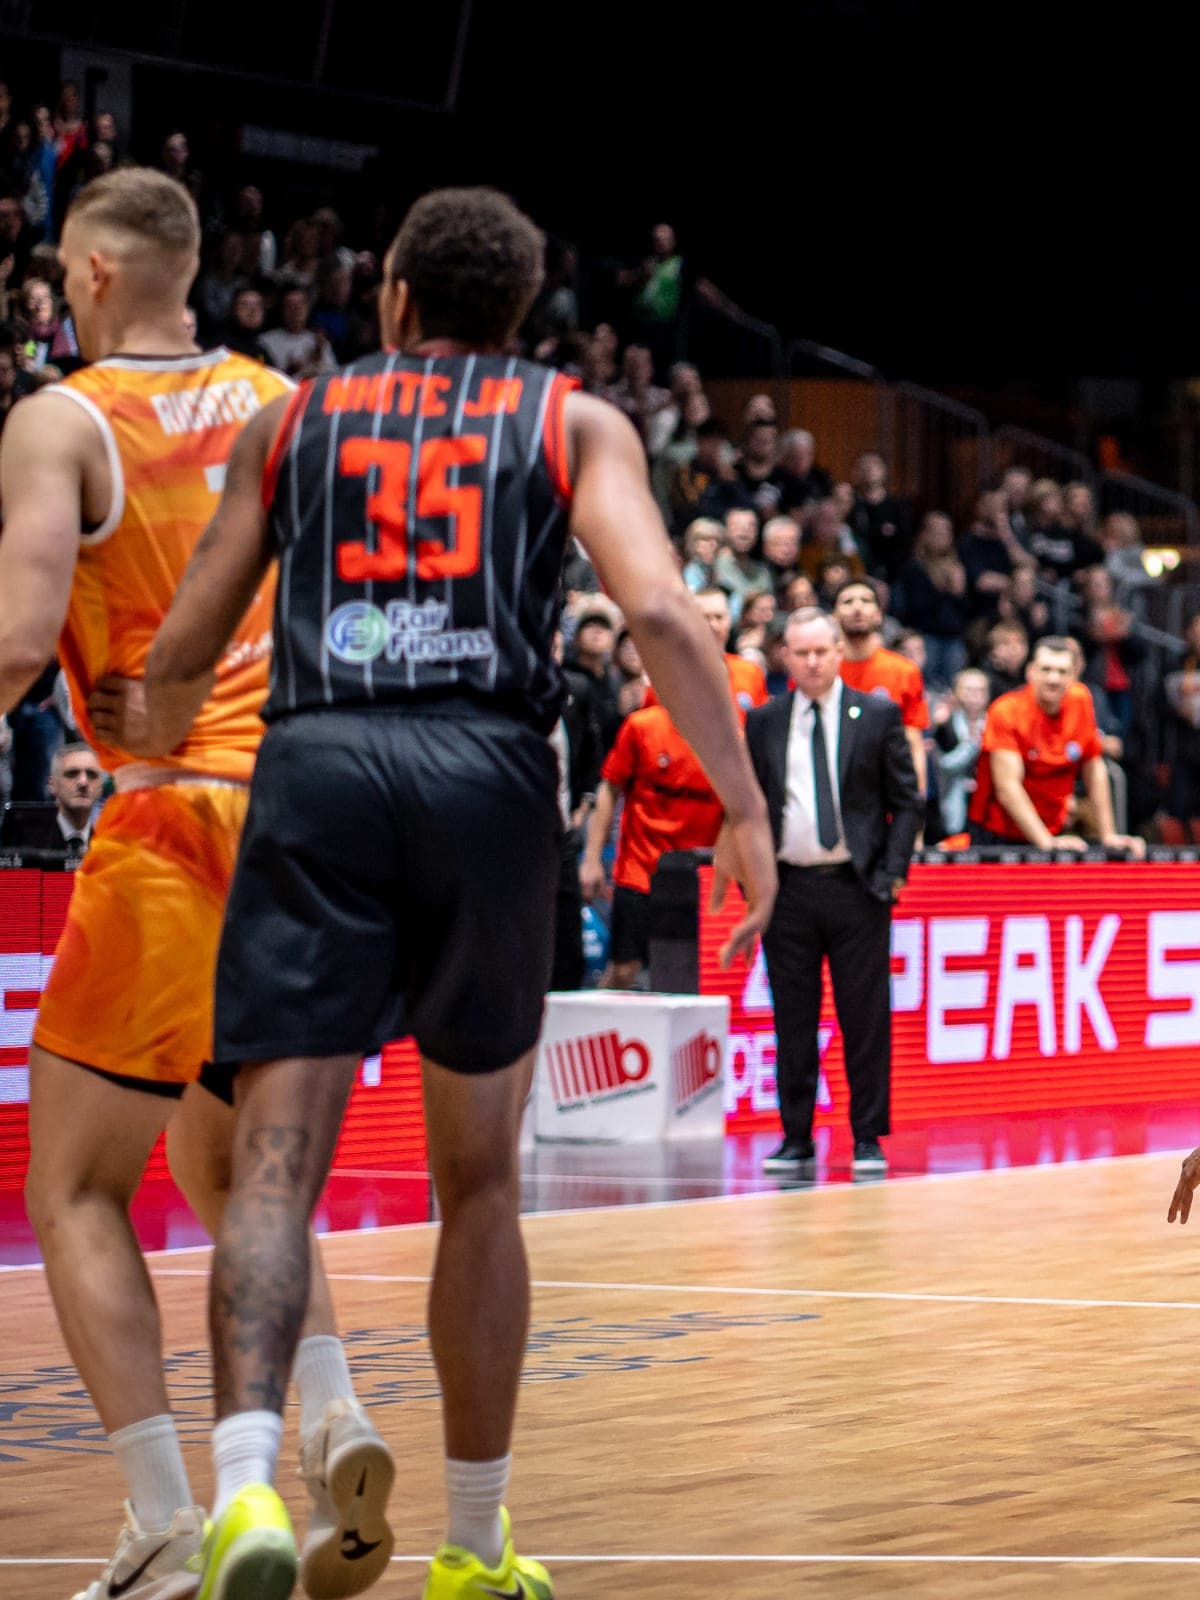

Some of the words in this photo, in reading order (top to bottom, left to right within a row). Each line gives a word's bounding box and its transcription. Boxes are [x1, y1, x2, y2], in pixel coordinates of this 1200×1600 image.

[322, 371, 451, 417] WHITE
[336, 434, 487, 584] 35
[385, 600, 449, 631] Fair
[385, 629, 497, 662] Finans
